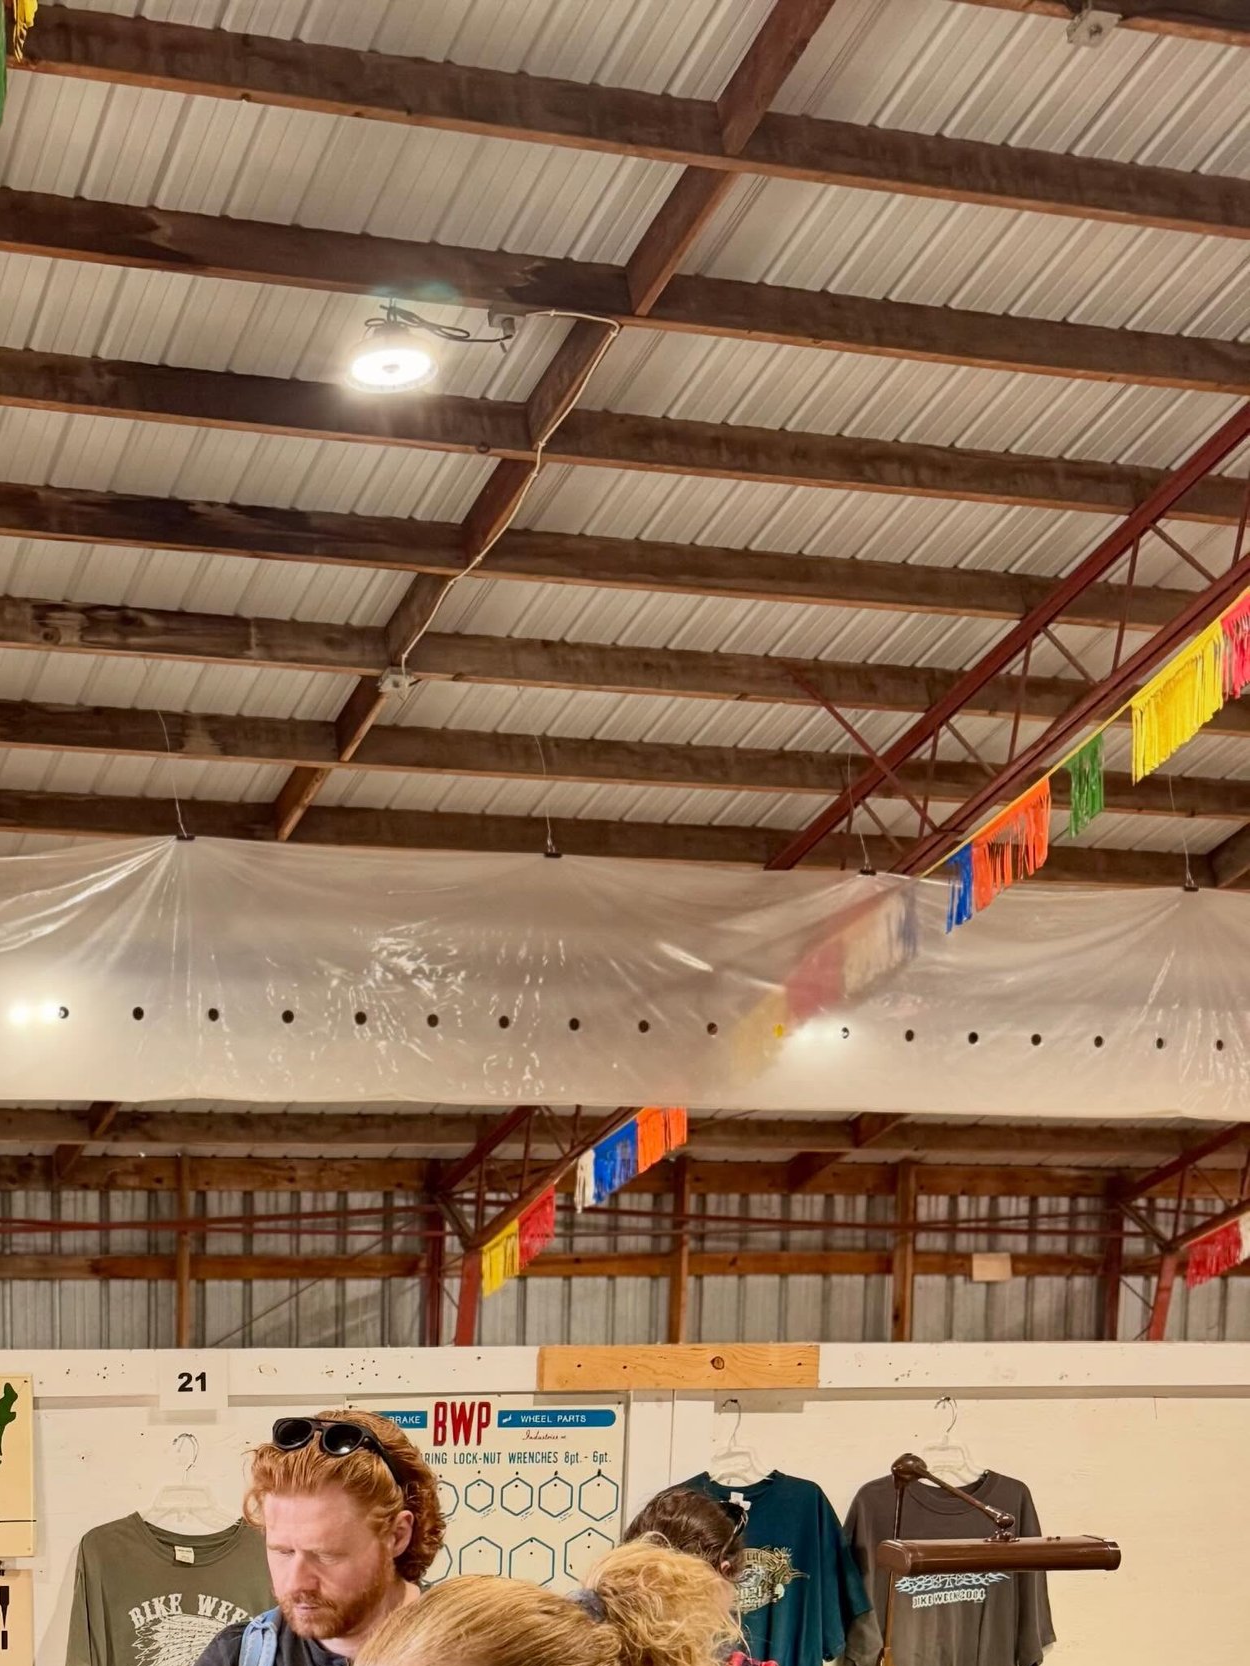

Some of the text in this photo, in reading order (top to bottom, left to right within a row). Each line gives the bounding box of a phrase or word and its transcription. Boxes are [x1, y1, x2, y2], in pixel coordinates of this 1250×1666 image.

[177, 1372, 208, 1393] 21
[388, 1401, 587, 1446] BRAKE BWP WHEEL PARTS
[453, 1451, 502, 1465] LOCK-NUT
[508, 1451, 558, 1464] WRENCHES
[128, 1593, 253, 1629] BIKE WEE
